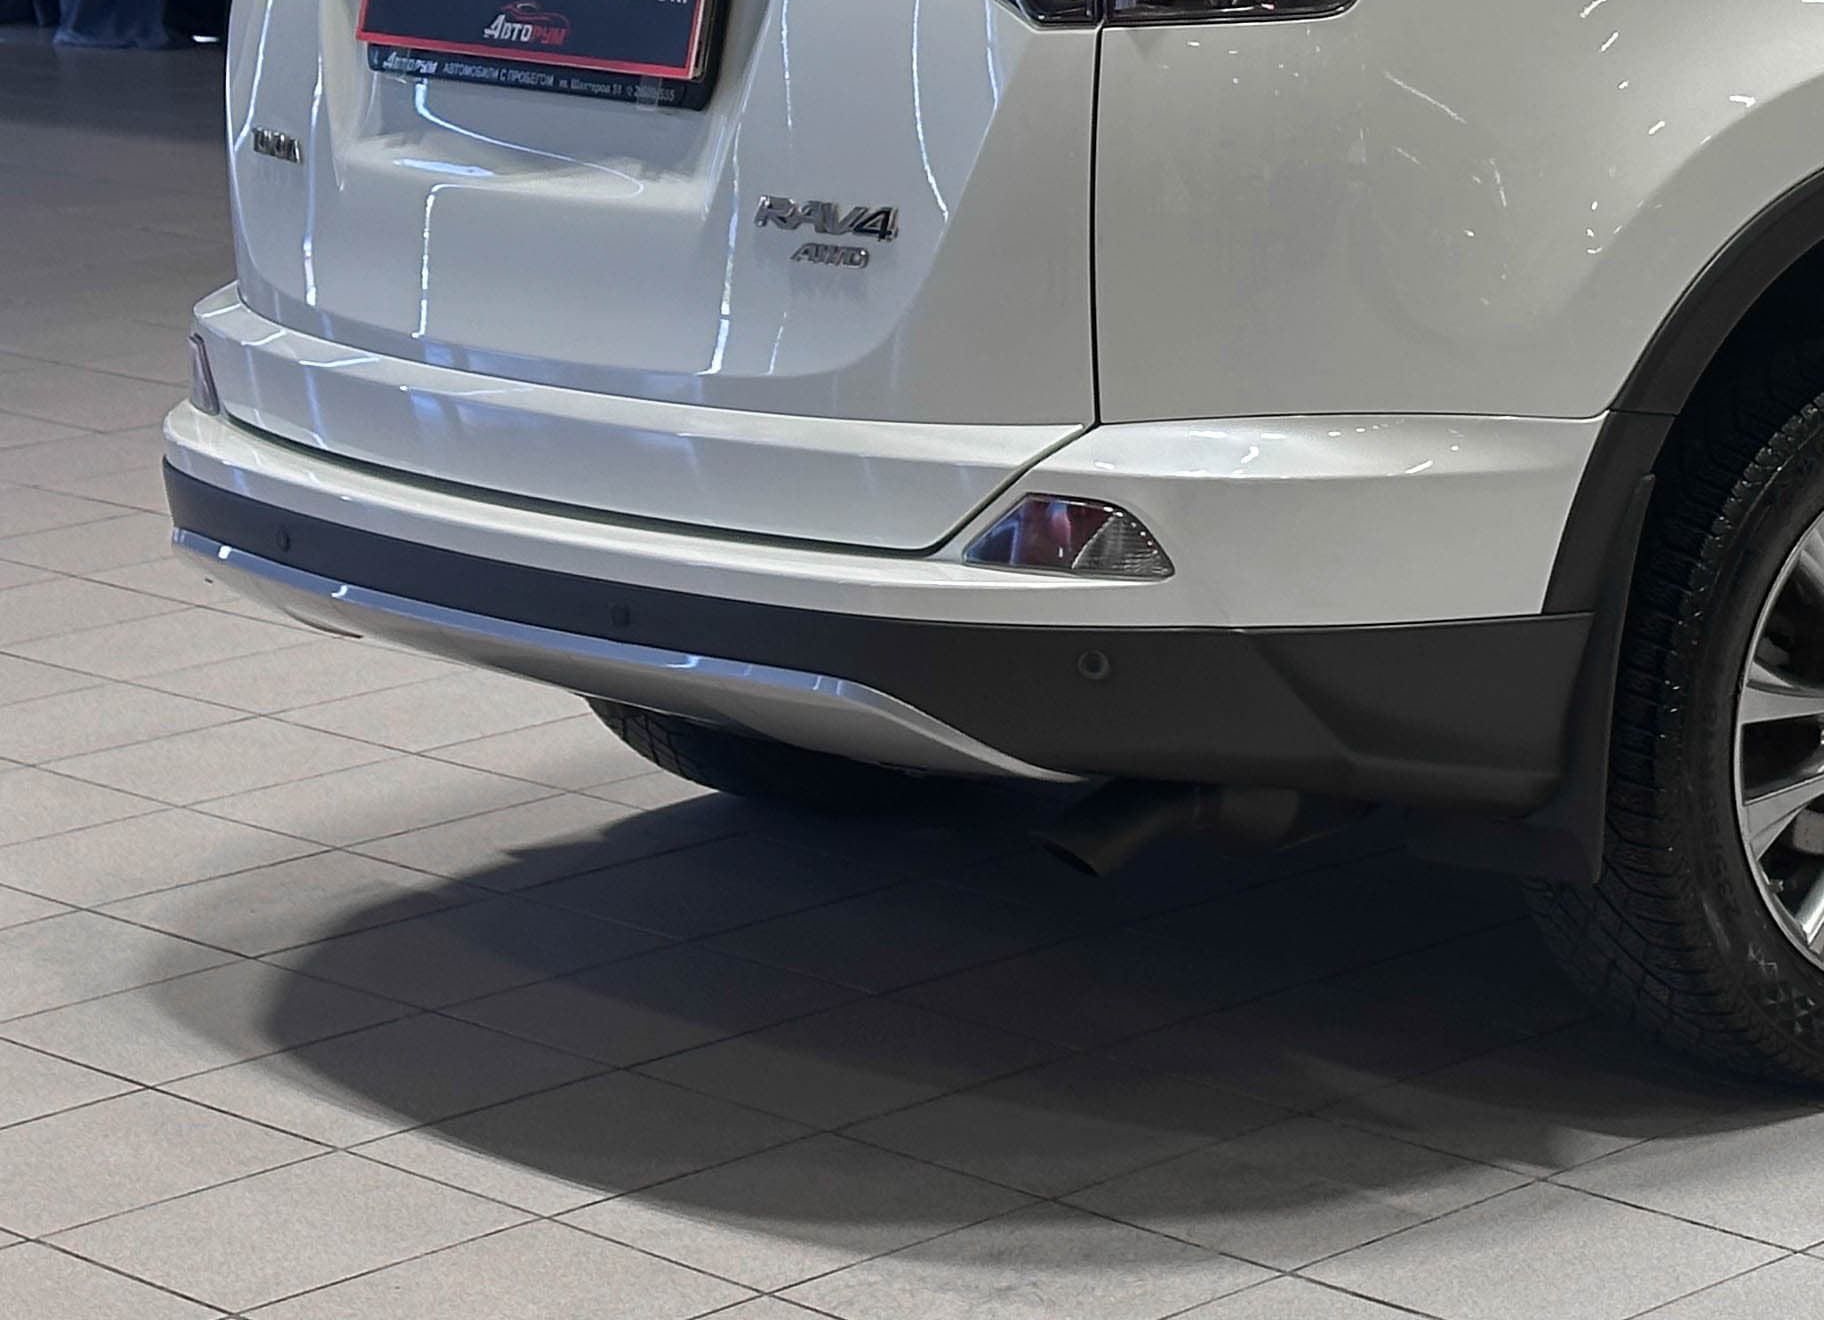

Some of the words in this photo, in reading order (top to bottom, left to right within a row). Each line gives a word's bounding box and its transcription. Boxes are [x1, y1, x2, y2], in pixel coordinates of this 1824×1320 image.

[507, 68, 555, 88] ПРОБЕГОМ
[754, 195, 899, 242] RAV4
[790, 242, 870, 269] AWD
